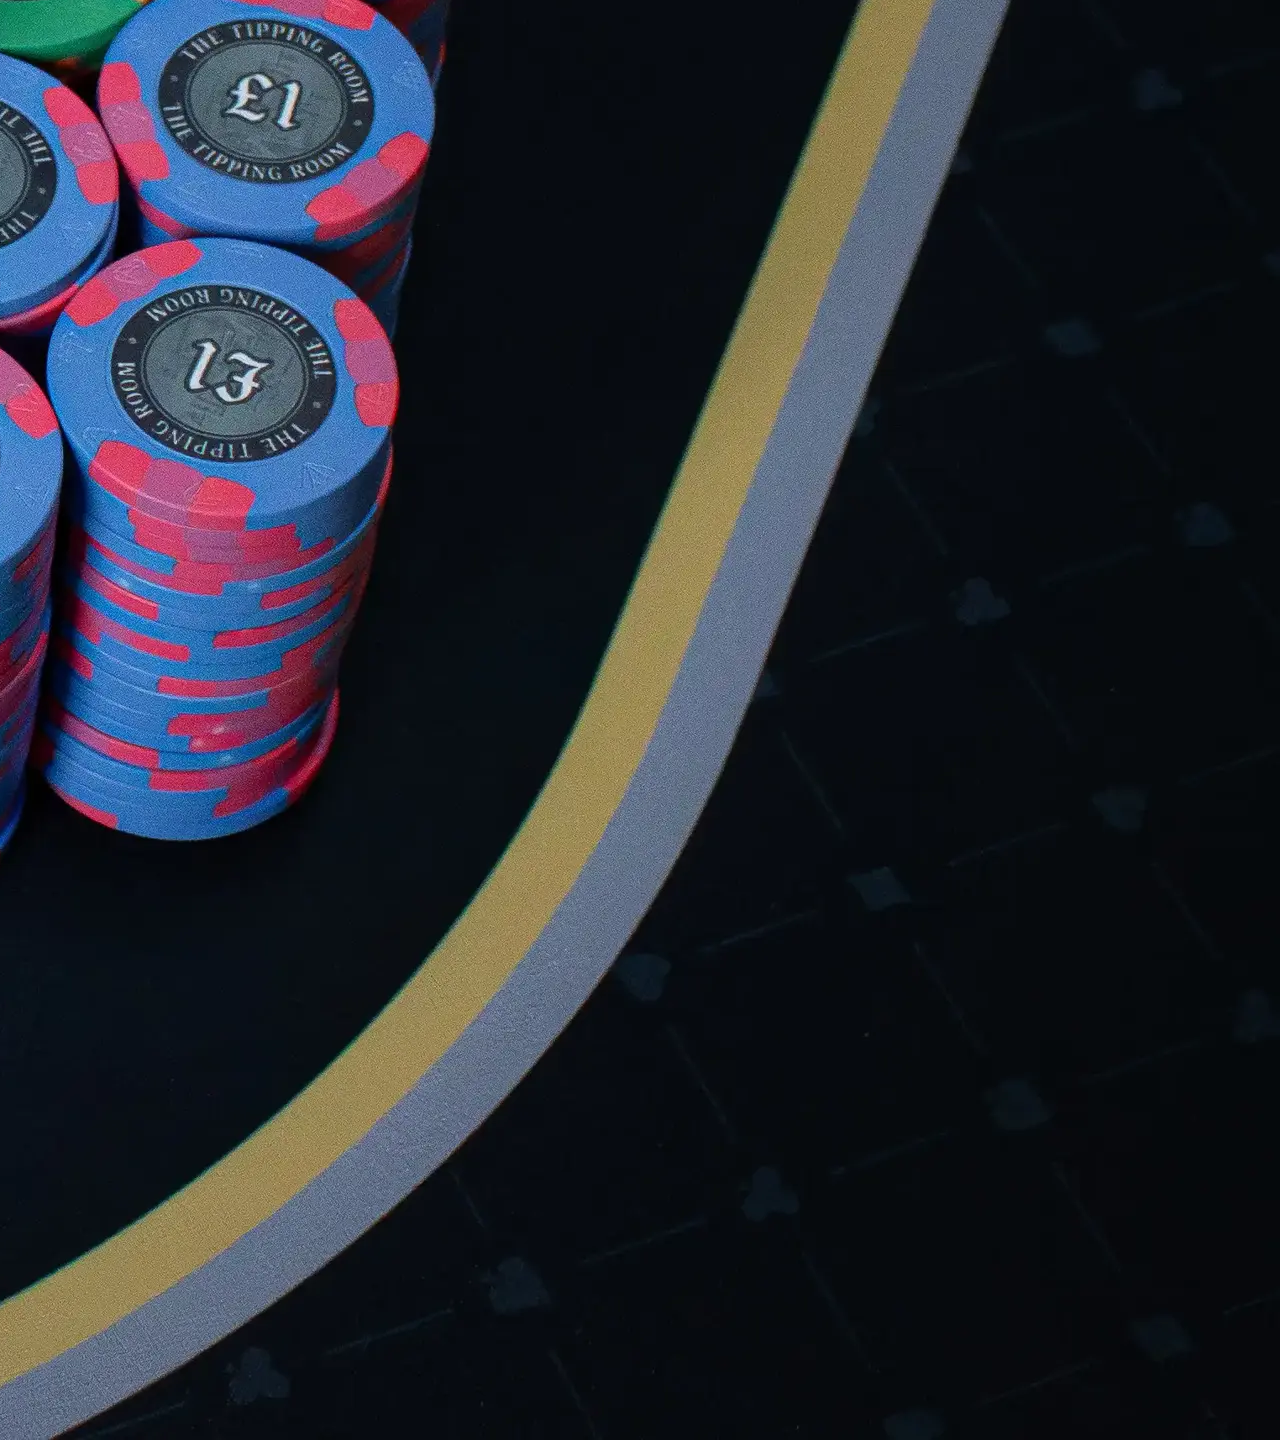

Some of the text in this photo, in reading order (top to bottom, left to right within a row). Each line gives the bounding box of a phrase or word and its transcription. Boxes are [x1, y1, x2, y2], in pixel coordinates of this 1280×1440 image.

[180, 23, 368, 103] THE TIPPING ROOM
[227, 73, 300, 129] £1
[20, 129, 51, 166] THE
[163, 103, 351, 180] THE TIPPING ROOM
[144, 289, 331, 377] THE TIPPING ROOM
[117, 361, 307, 458] THE TIPPING ROOM
[188, 341, 268, 403] £1
